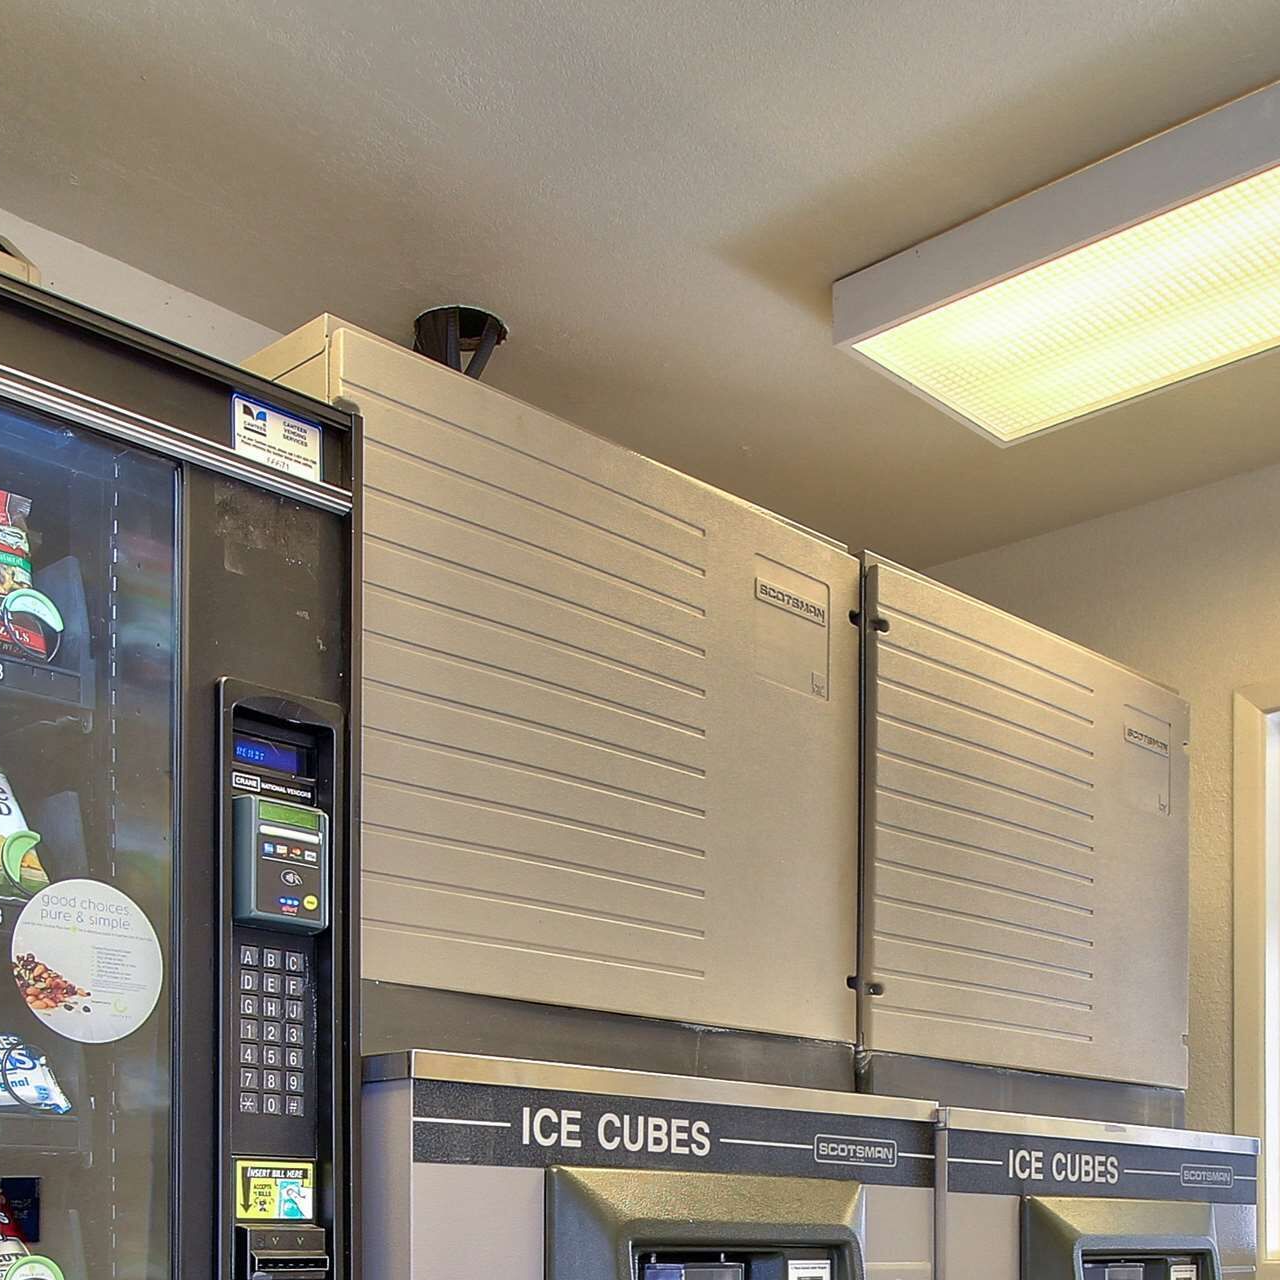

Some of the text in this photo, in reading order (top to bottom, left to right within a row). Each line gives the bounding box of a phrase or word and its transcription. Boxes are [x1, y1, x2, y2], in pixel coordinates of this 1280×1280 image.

[759, 583, 825, 624] SCOTSMAN
[41, 893, 77, 909] good
[40, 909, 72, 922] pure
[76, 911, 85, 924] &
[522, 1106, 712, 1157] ICE CUBES
[818, 1140, 894, 1162] SCOTSMAN
[247, 1167, 271, 1178] INSERT
[1007, 1148, 1119, 1184] ICE CUBES
[1183, 1169, 1232, 1184] SCOTSMAN
